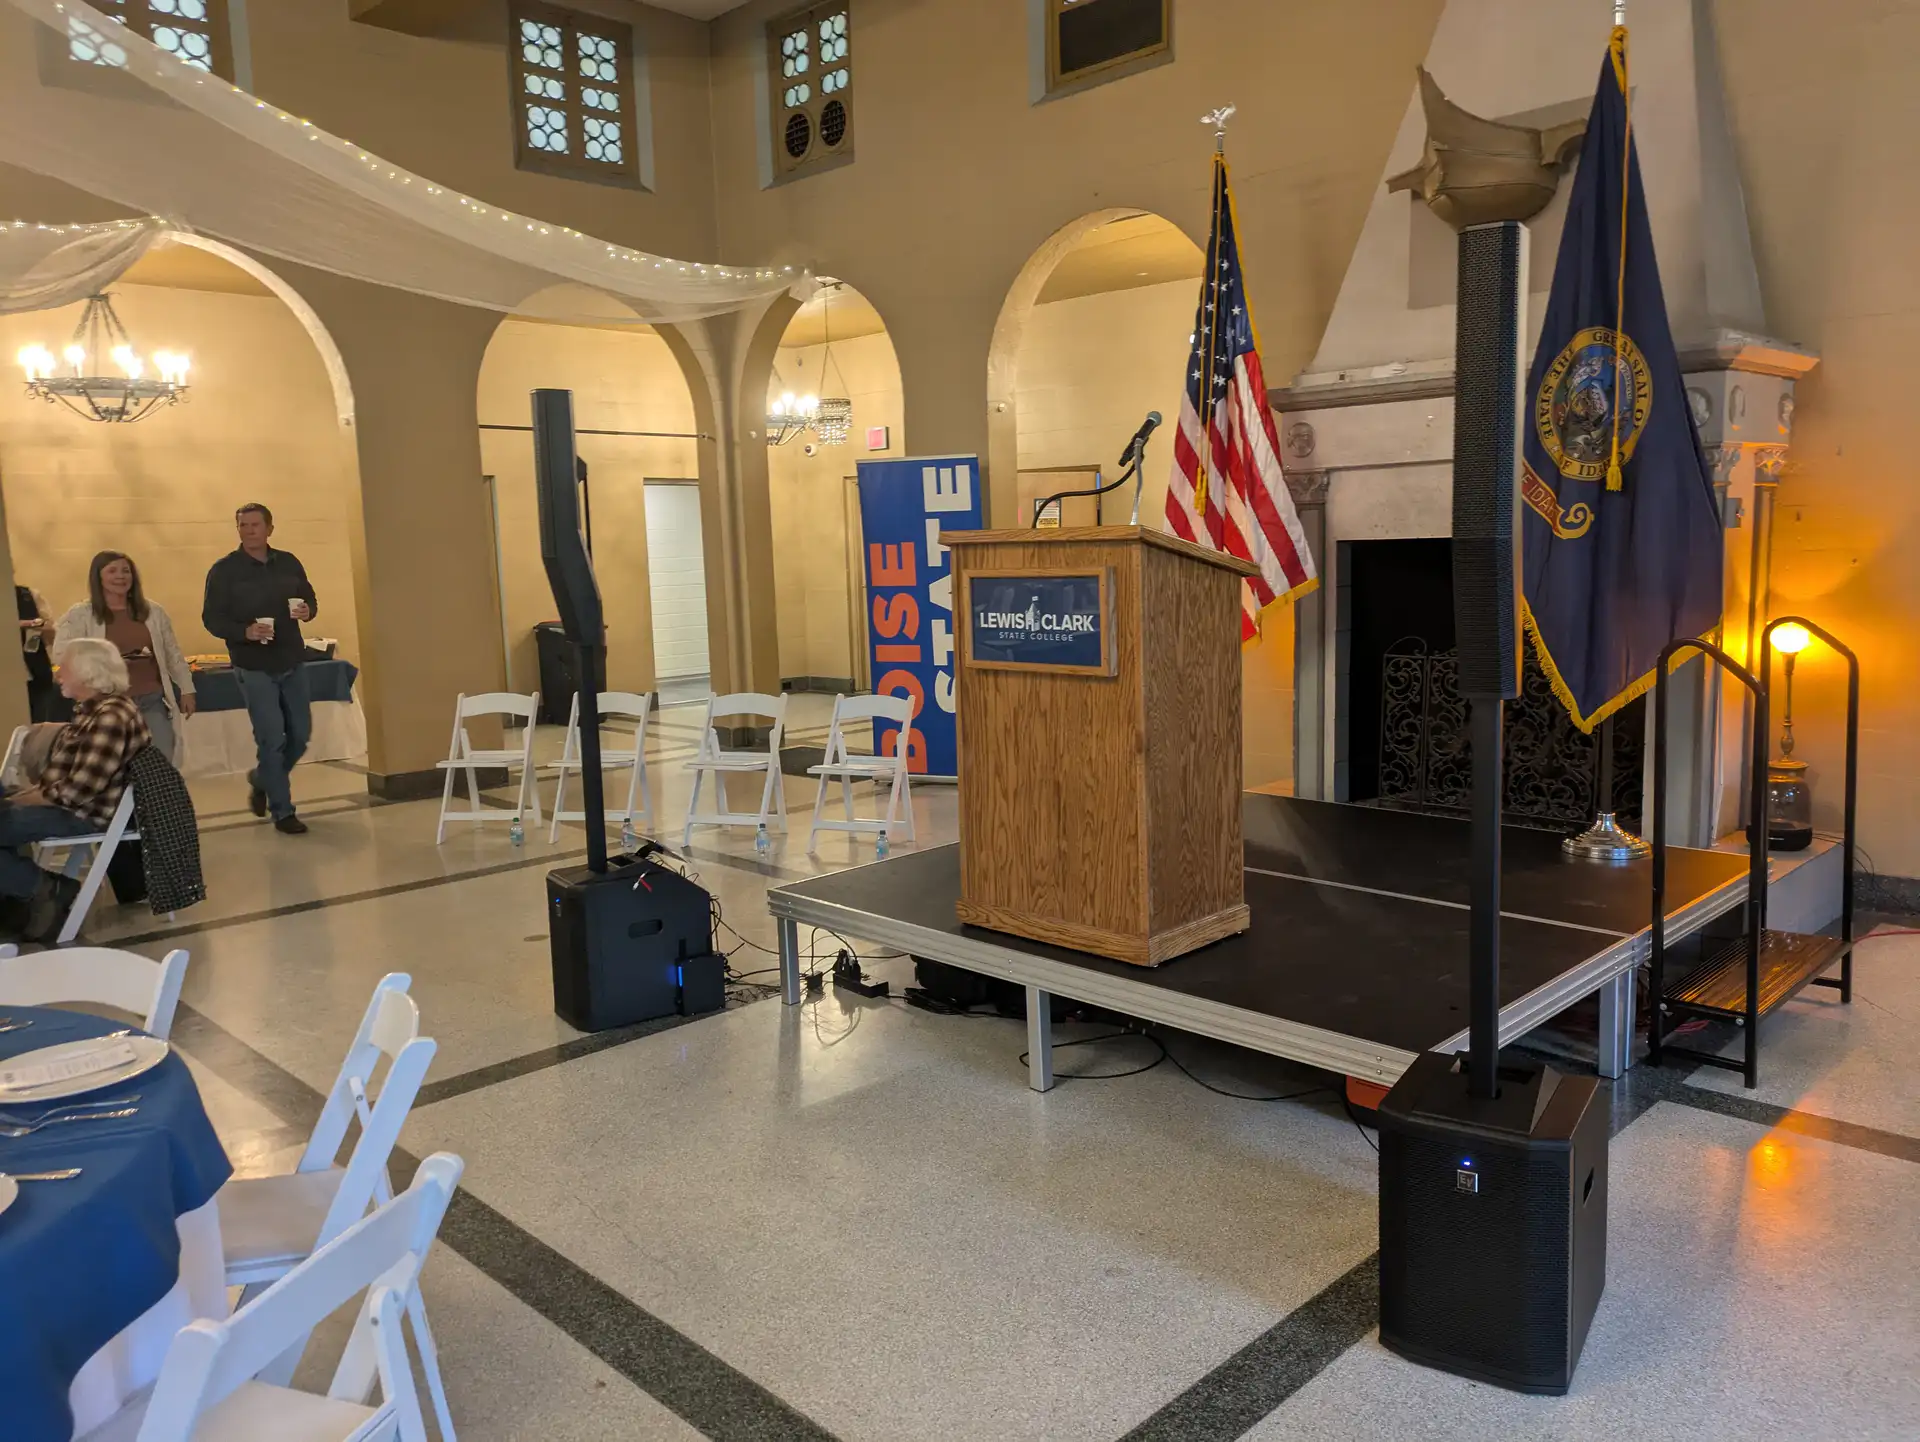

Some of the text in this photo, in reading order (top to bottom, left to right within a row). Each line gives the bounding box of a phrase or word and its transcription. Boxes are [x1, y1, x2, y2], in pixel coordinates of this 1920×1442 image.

[1540, 384, 1554, 440] STATE
[1526, 484, 1556, 517] IDAH
[979, 612, 1095, 632] LEWIS CLARK
[998, 631, 1074, 642] STATE COLLEGE
[869, 541, 928, 774] BOISE
